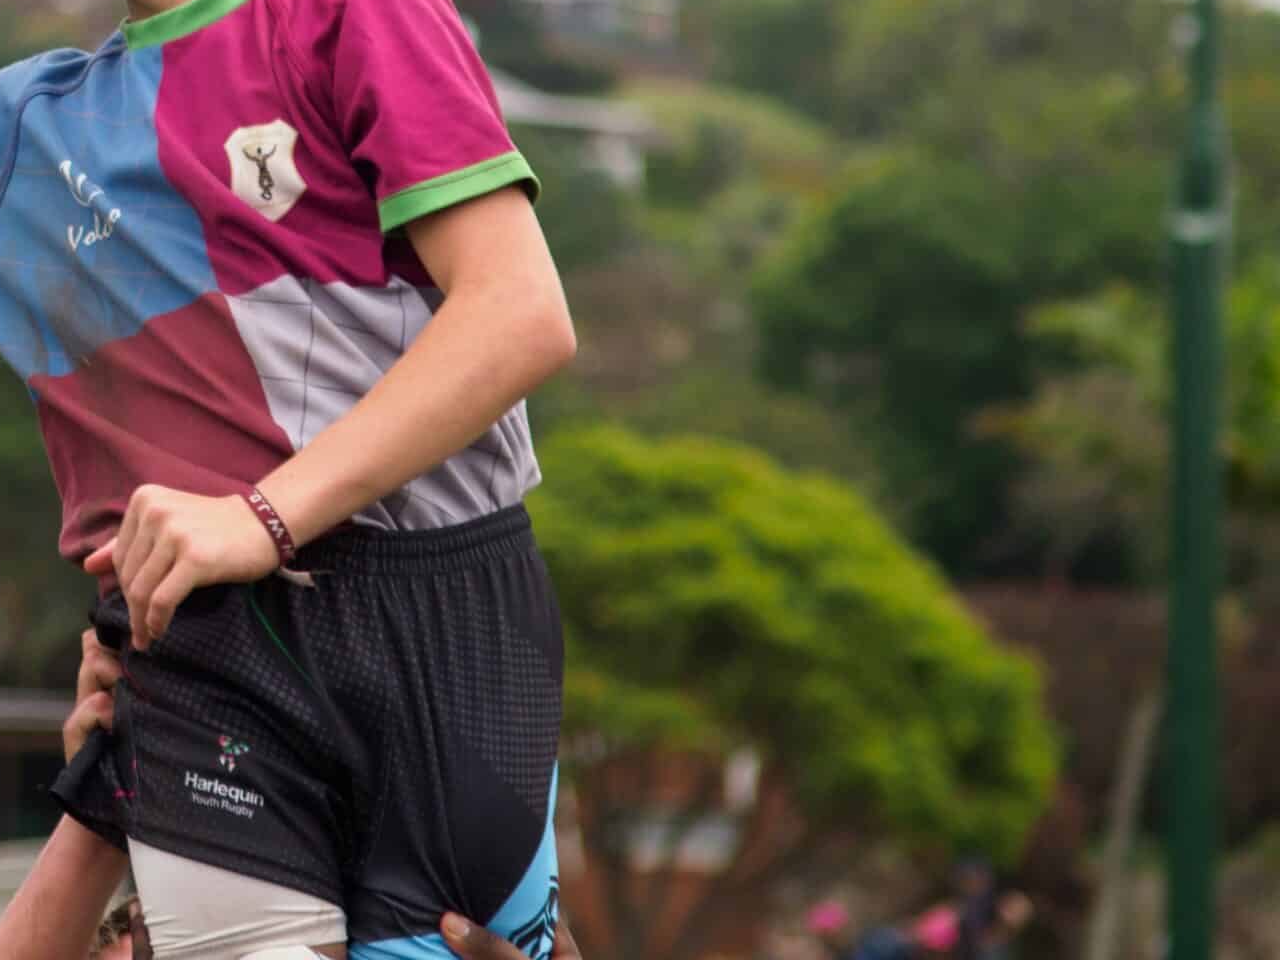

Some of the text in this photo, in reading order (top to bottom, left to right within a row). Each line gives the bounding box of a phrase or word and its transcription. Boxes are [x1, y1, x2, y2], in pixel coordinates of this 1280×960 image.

[184, 770, 265, 807] Harlequin
[191, 791, 254, 819] Youth Rugby
